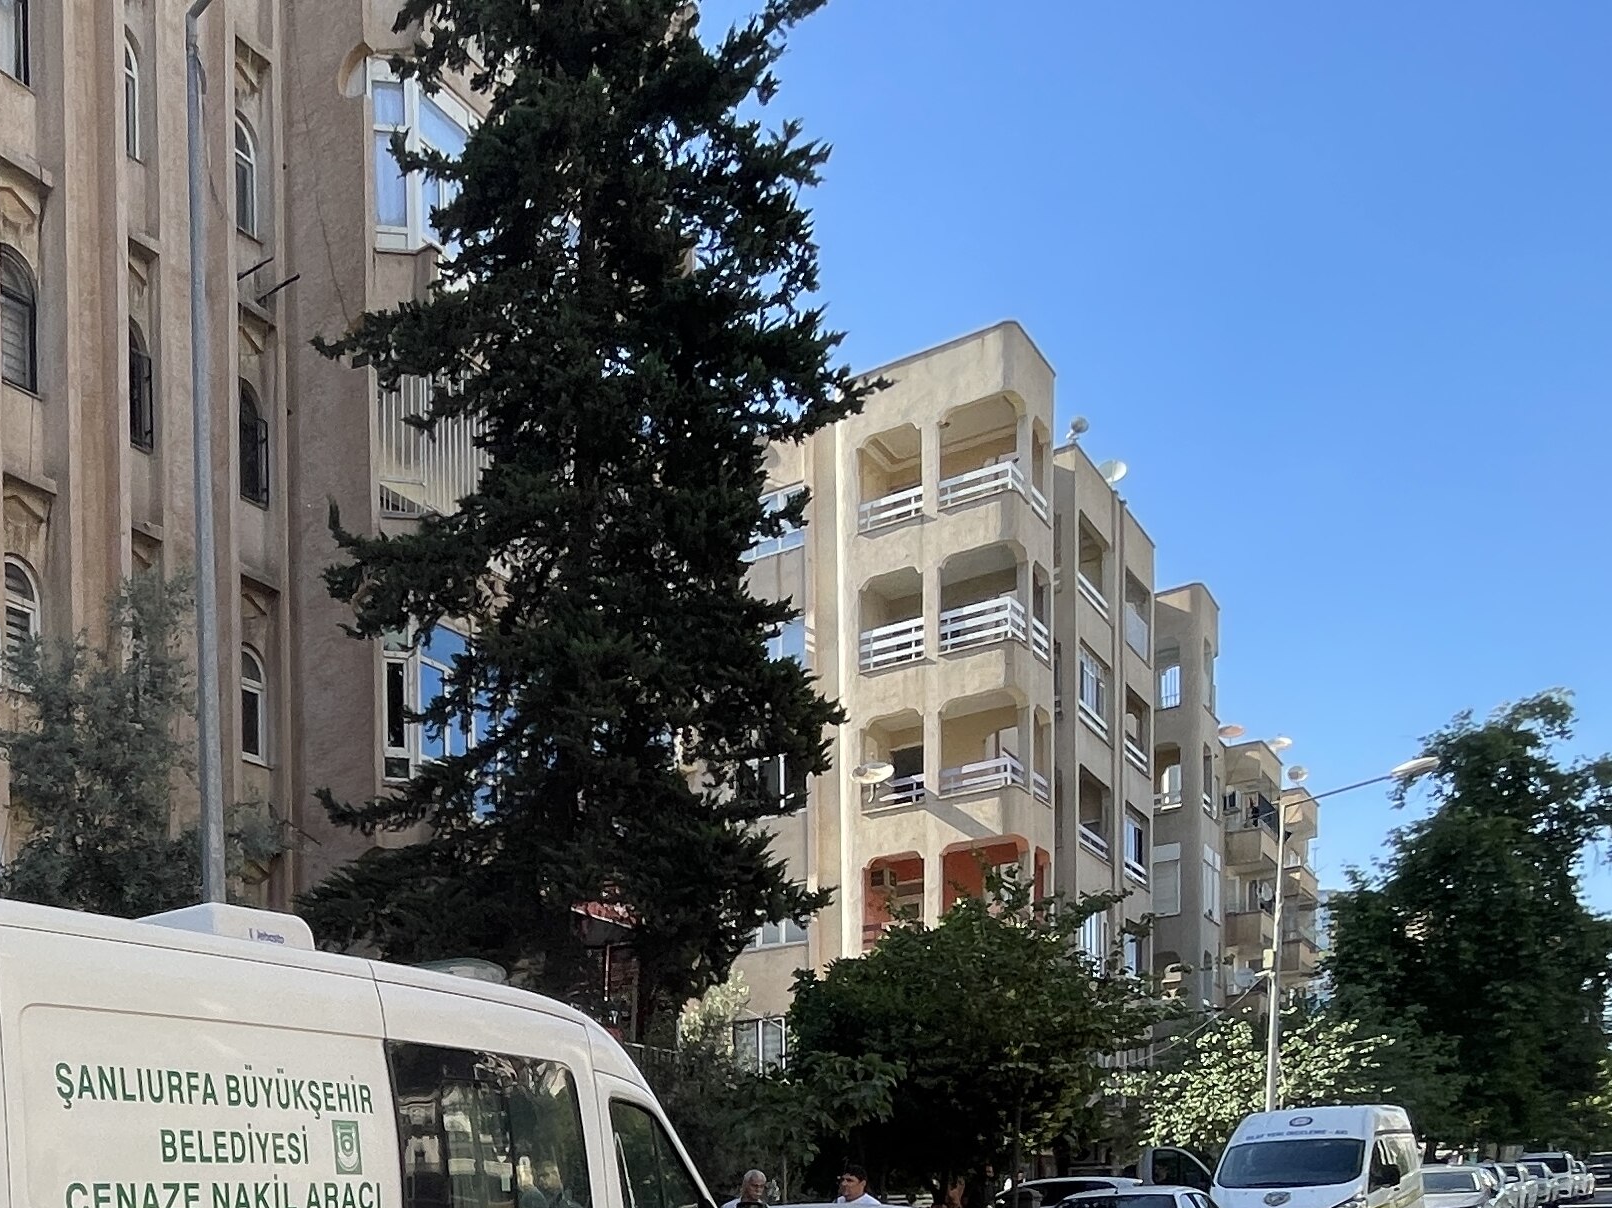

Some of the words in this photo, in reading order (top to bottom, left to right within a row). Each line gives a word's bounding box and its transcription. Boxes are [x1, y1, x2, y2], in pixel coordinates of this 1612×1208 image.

[55, 1062, 219, 1109] ŞANLIURFA
[225, 1064, 374, 1119] BÜYÜKŞEHİR
[160, 1123, 309, 1164] BELEDİYESİ
